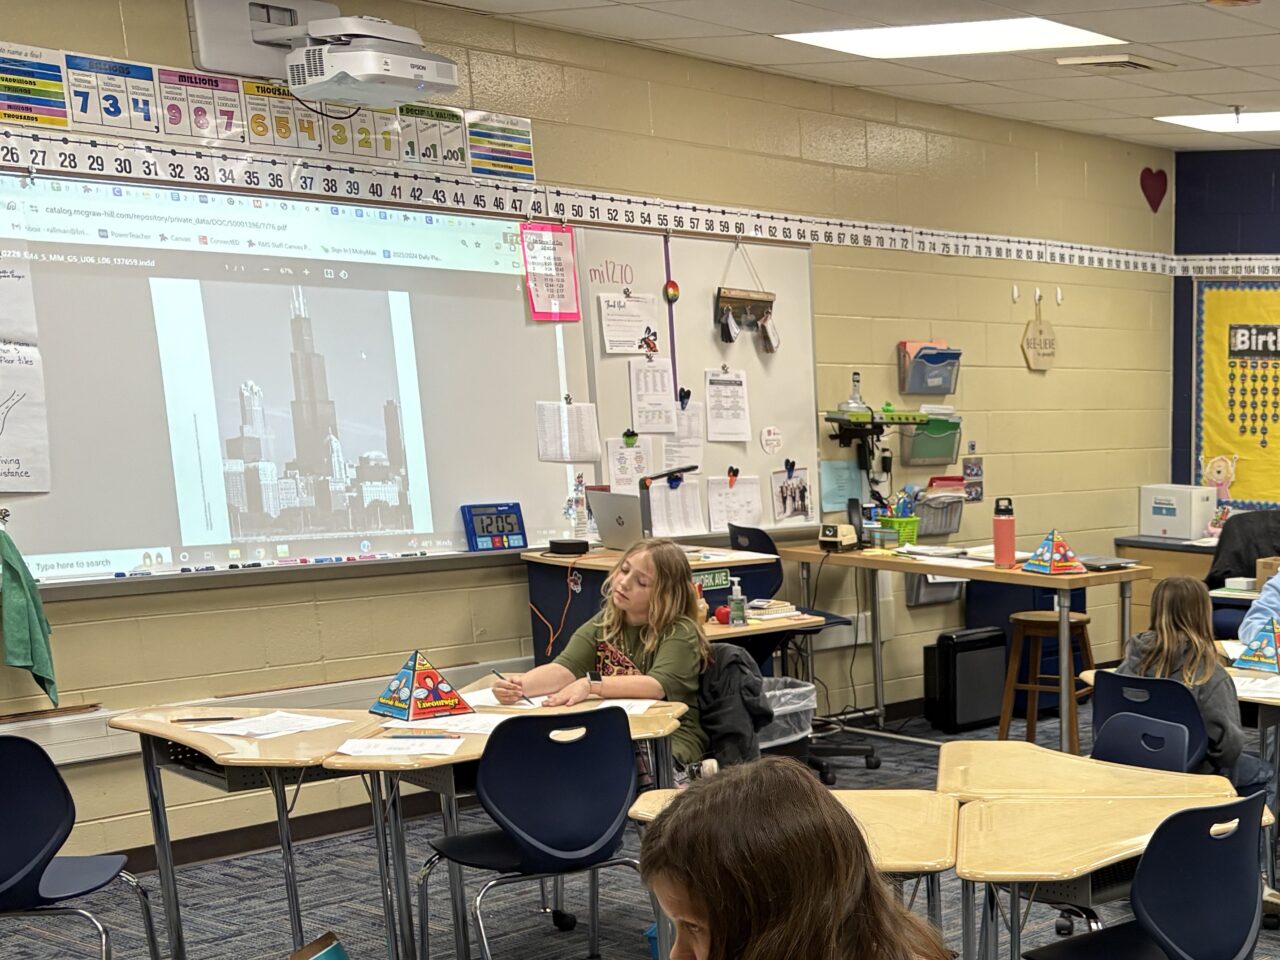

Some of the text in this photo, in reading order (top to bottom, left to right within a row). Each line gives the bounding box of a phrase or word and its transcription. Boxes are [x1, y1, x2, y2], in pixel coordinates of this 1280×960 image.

[74, 90, 89, 113] 7
[103, 95, 121, 117] 3
[167, 104, 182, 125] 9
[194, 107, 209, 129] 8
[220, 110, 234, 131] 7
[1, 146, 744, 234] 26 27 28 29 30 31 32 33 34 35 36 37 38 39 40 41 42 43 44 45 46 47 48 49 50 51 52 53 54 55 56 57 58 59 60
[715, 572, 728, 585] AVE
